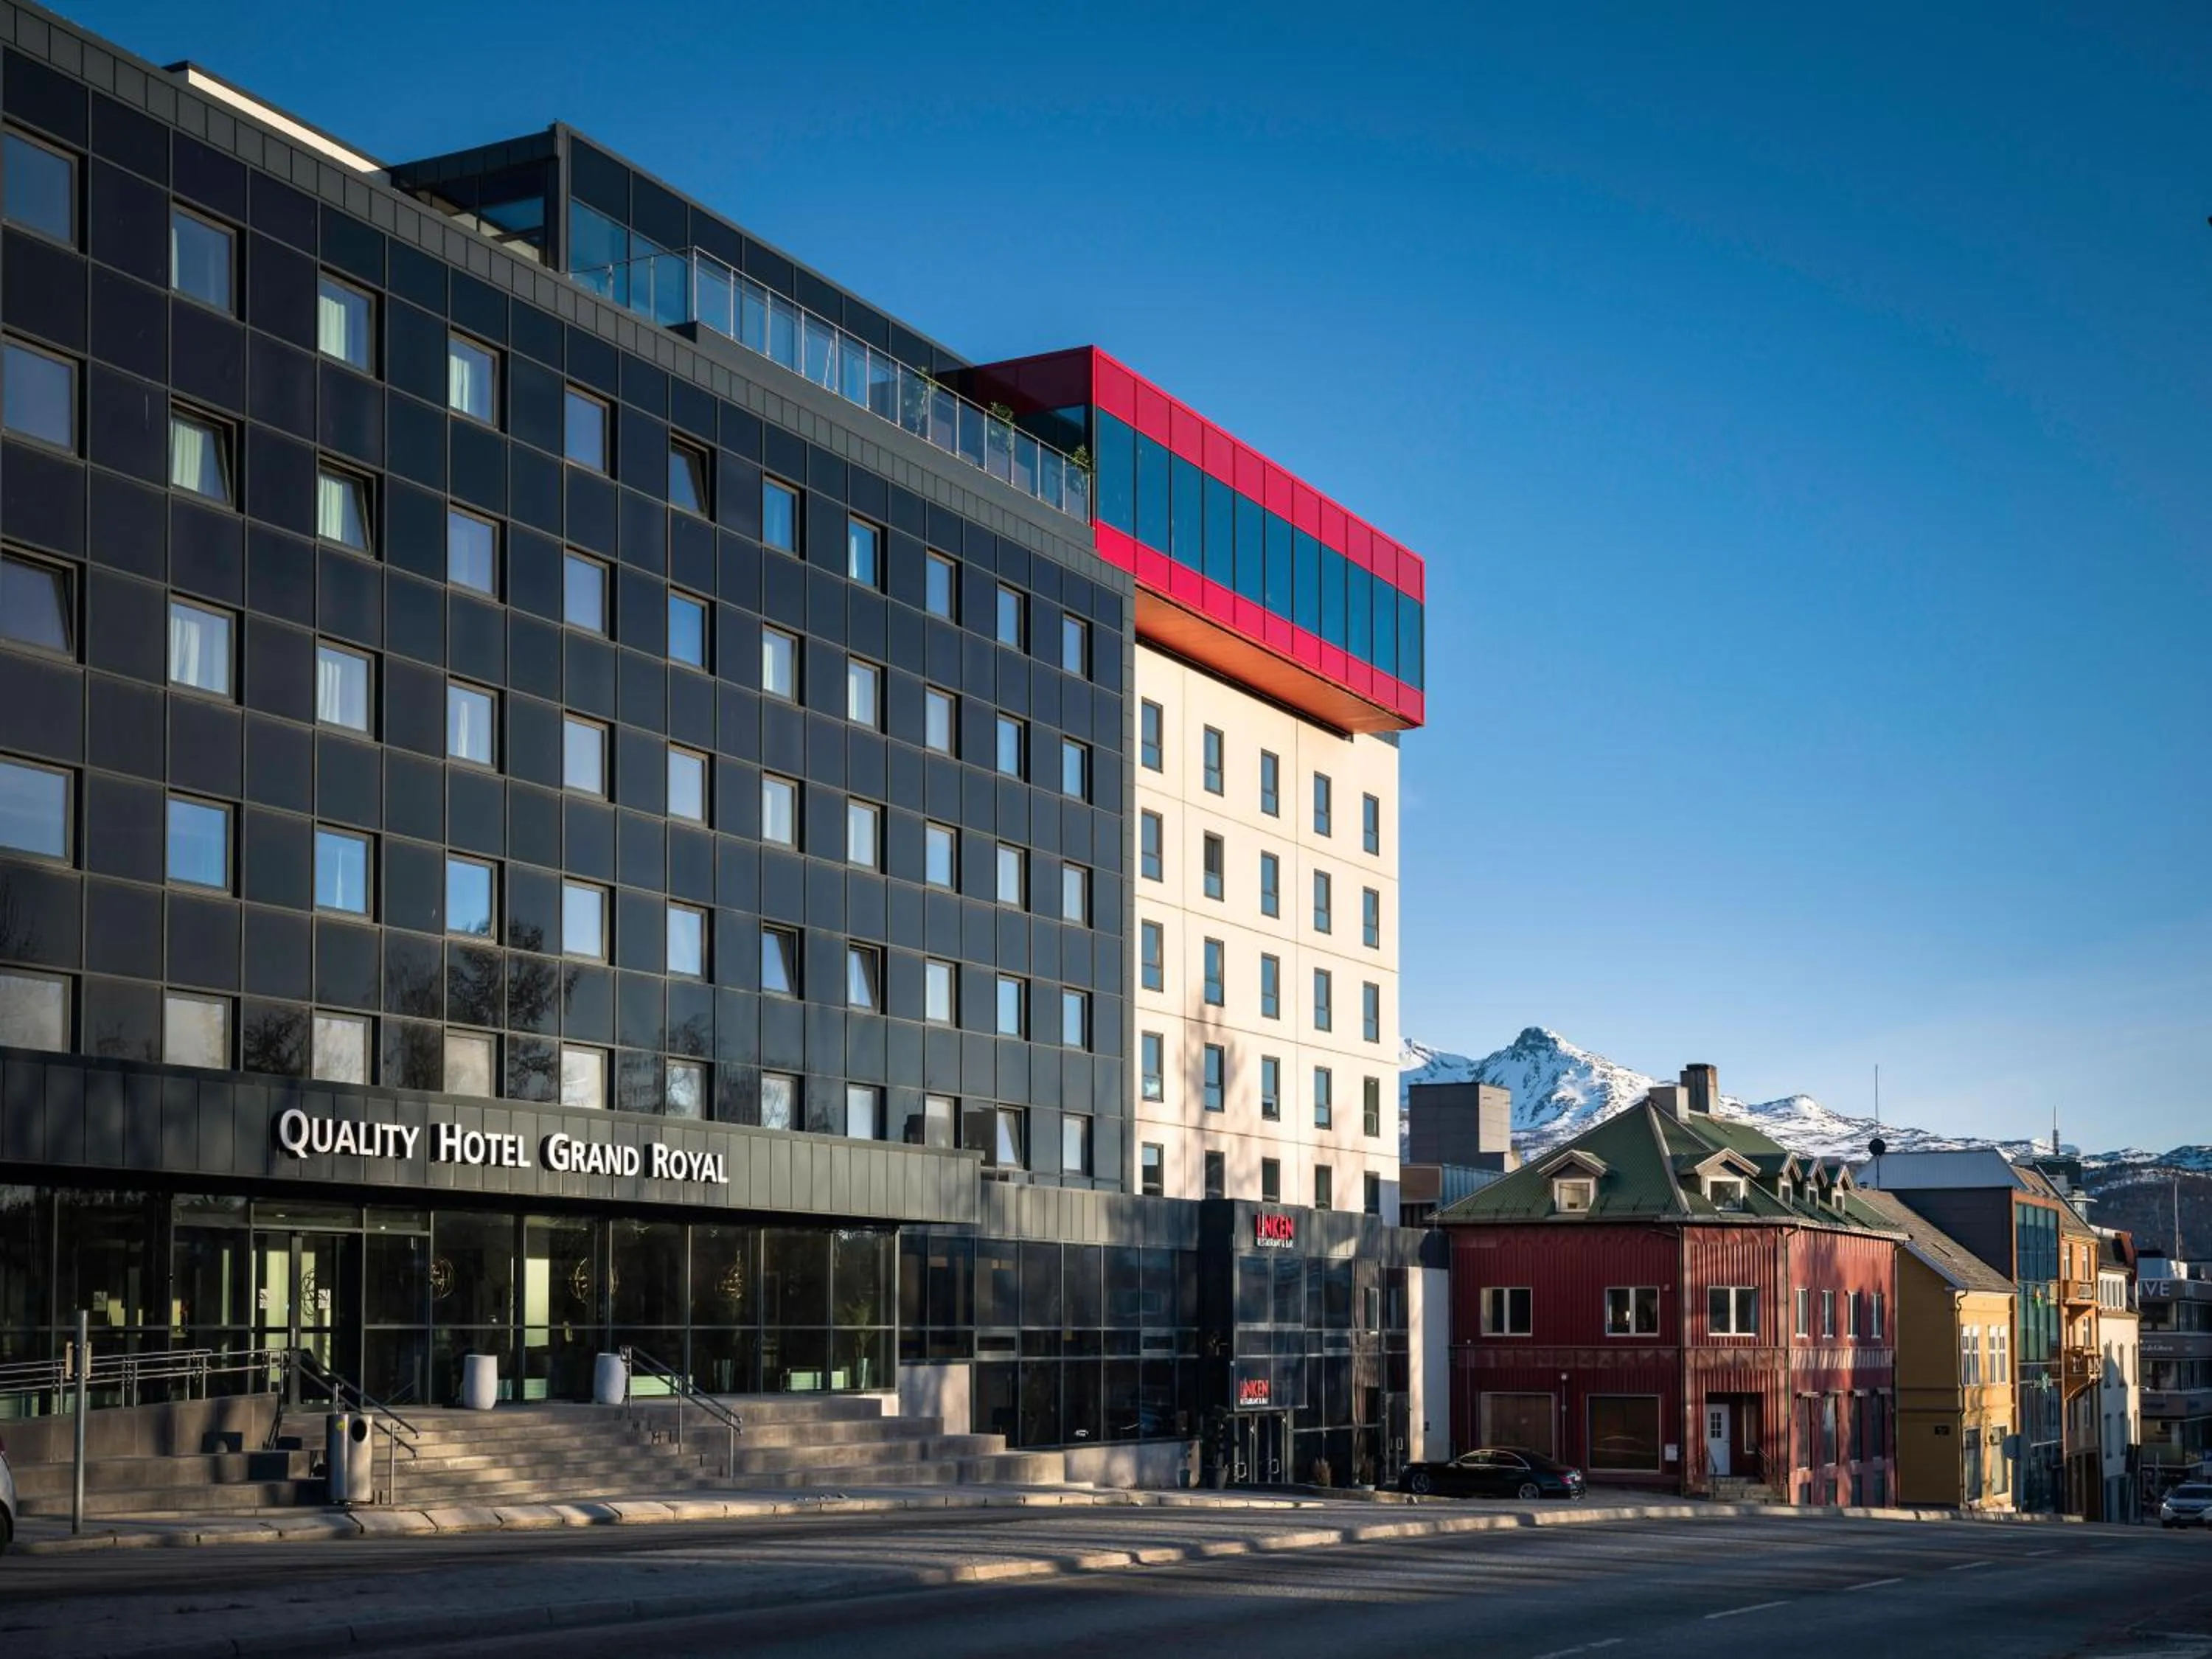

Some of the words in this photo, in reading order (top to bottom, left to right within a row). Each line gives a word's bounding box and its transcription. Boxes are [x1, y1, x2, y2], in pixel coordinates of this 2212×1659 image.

[279, 1108, 420, 1159] QUALITY
[439, 1123, 531, 1168] HOTEL
[548, 1133, 640, 1177] GRAND
[652, 1142, 729, 1183] ROYAL
[1256, 1210, 1293, 1239] LINKEN
